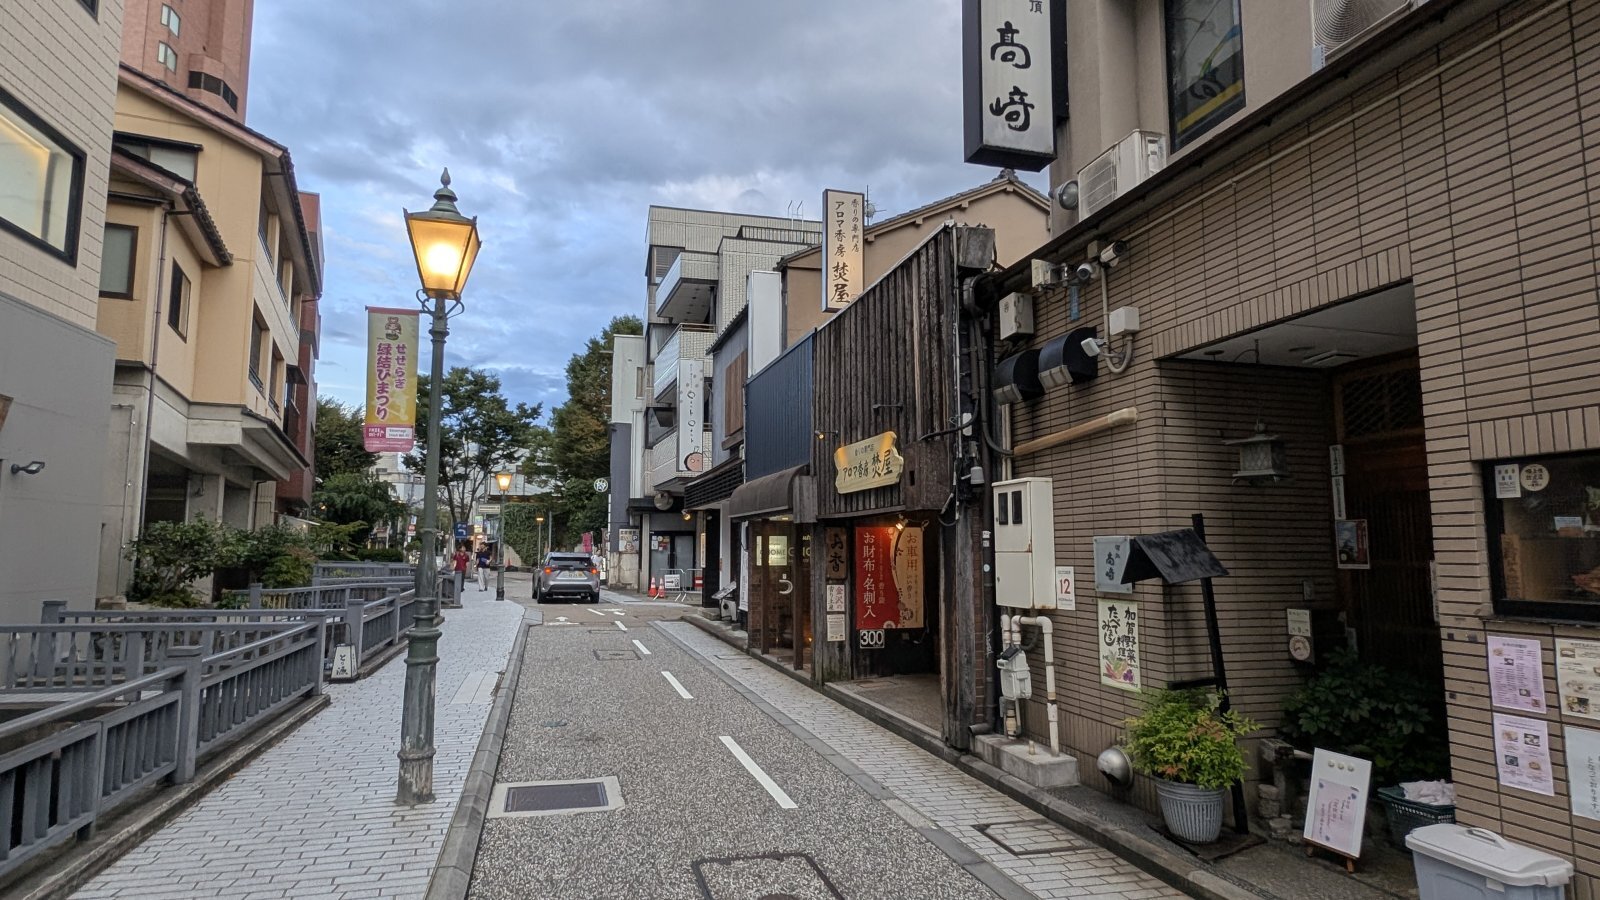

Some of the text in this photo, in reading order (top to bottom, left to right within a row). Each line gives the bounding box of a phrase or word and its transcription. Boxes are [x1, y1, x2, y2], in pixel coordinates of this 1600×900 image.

[395, 342, 406, 389] せせらぎ
[829, 533, 845, 572] お香
[863, 532, 876, 618] お財布・名刺入
[1059, 578, 1071, 594] 12
[860, 630, 883, 645] 300
[1123, 606, 1137, 664] 加賀野菜
